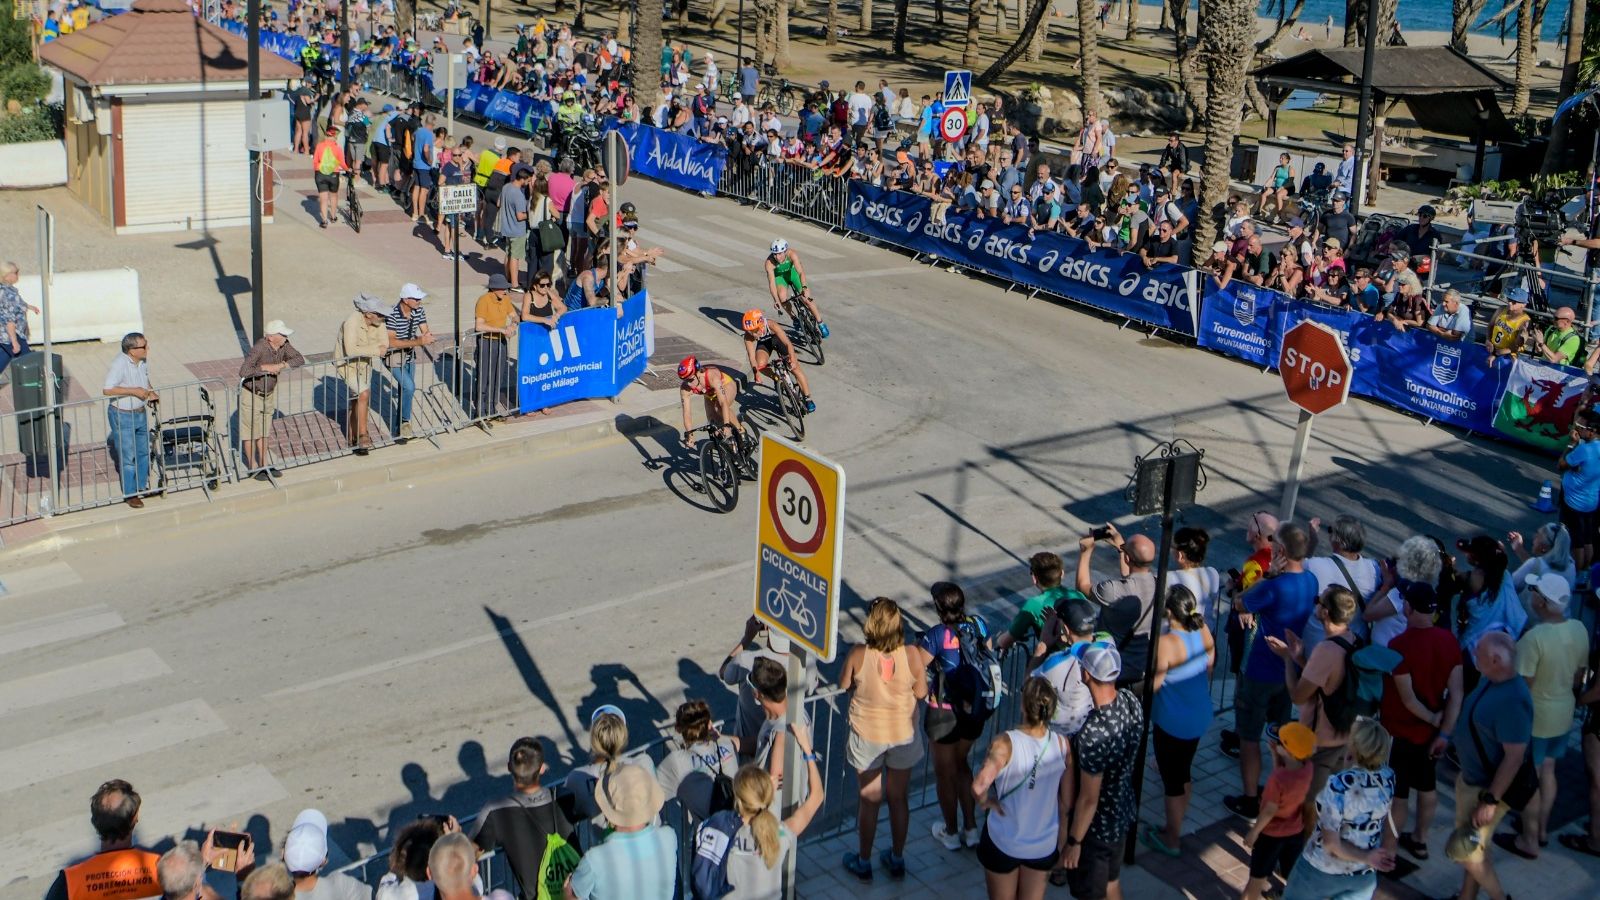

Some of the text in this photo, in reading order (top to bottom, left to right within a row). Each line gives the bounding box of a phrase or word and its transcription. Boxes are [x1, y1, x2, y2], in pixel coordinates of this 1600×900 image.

[946, 118, 963, 131] 30
[645, 135, 716, 186] Andalucía
[453, 189, 473, 198] CALLE
[865, 200, 1191, 312] asics asics asics asics asic
[1212, 321, 1272, 348] Torremolinos
[1216, 336, 1265, 357] AYUNTAMIENTO
[521, 367, 562, 385] Diputación
[563, 360, 603, 376] Provincial
[1284, 347, 1342, 389] STOP
[541, 376, 579, 392] de Málaga
[1404, 377, 1477, 411] Torremolinos
[1410, 396, 1468, 419] AYUNTAMIENTO
[782, 486, 812, 526] 30
[761, 547, 827, 597] CICLOCALLE
[86, 876, 153, 893] TORREMOLINOS
